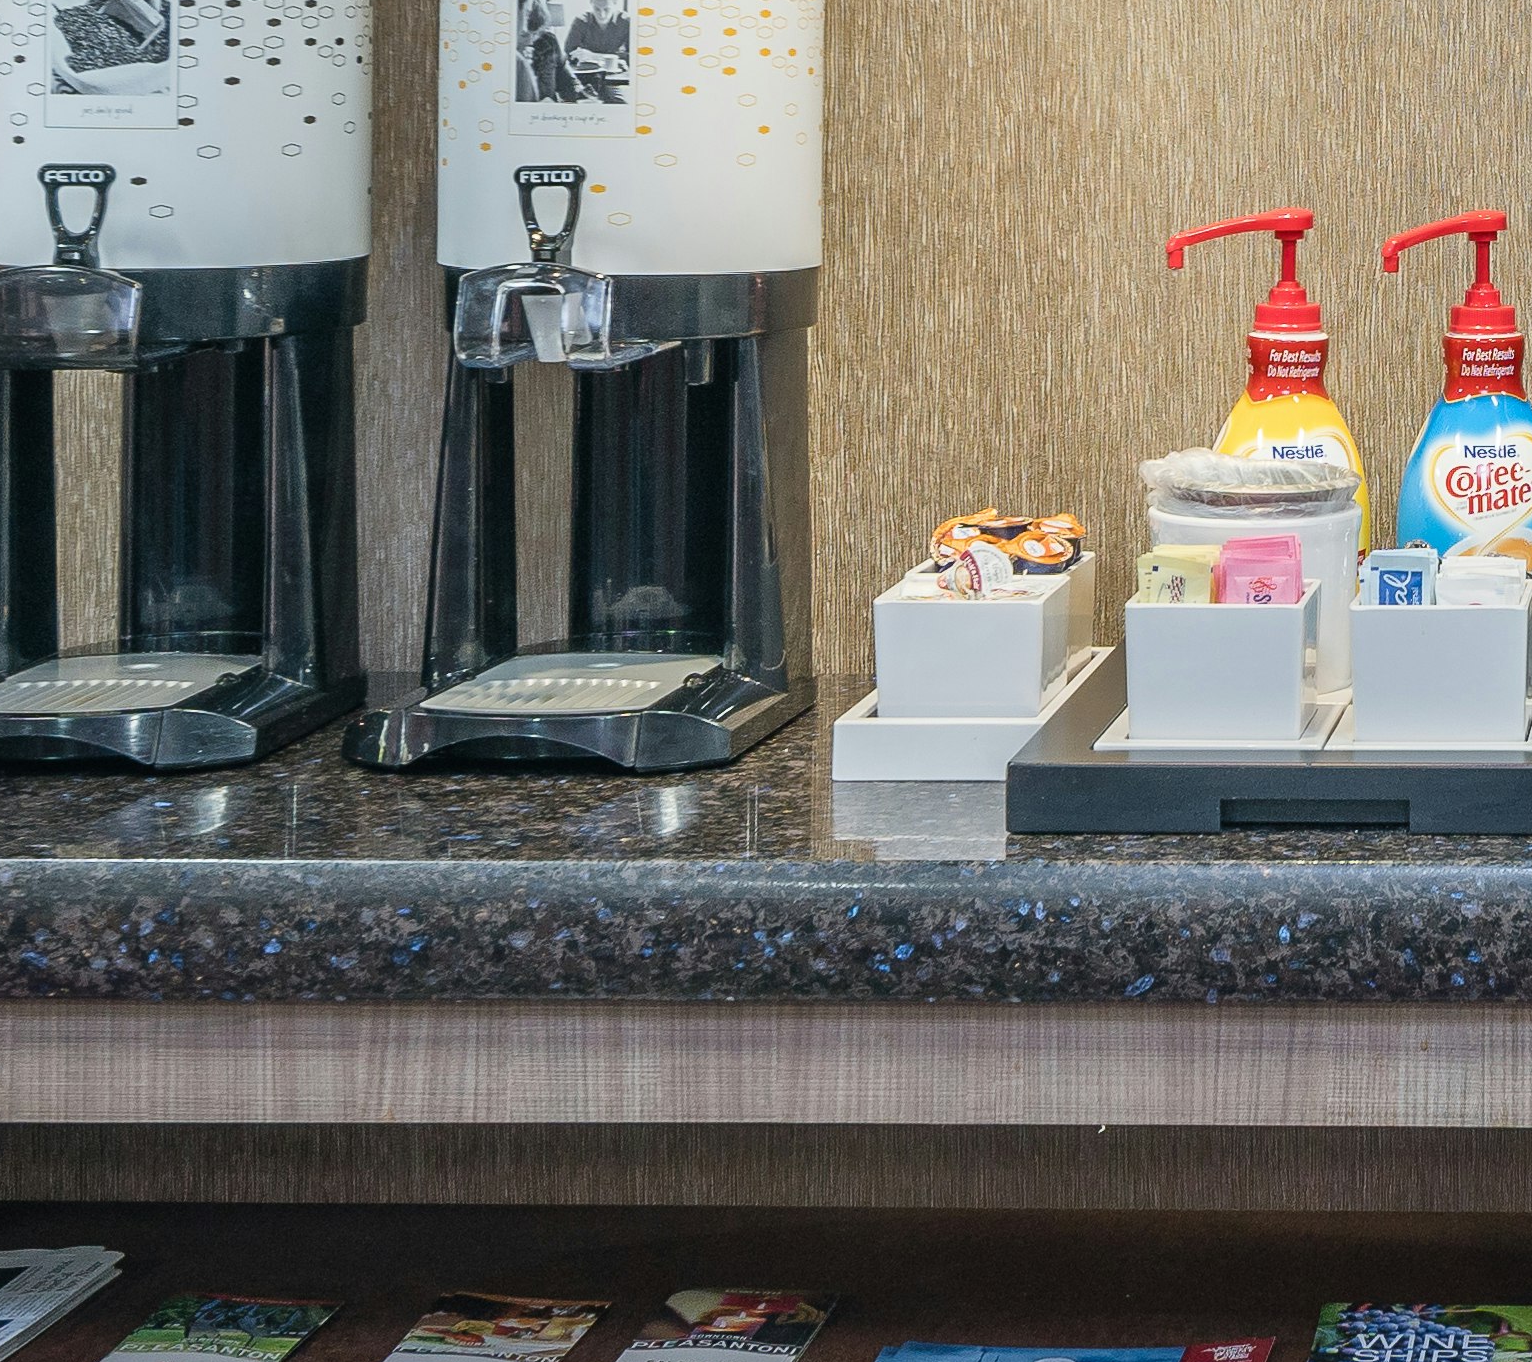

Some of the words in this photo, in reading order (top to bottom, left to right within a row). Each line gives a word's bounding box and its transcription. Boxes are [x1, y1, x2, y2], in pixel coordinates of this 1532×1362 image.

[44, 170, 105, 183] FETCO
[519, 170, 574, 183] FETCO
[1269, 348, 1282, 362] For
[1282, 349, 1299, 363] Best
[1299, 349, 1322, 363] Results
[1462, 347, 1475, 361] For
[1475, 348, 1492, 361] Best
[1492, 346, 1515, 361] Results
[1267, 364, 1277, 377] Do
[1461, 363, 1471, 376] Do
[1356, 1334, 1490, 1349] WINE
[120, 1343, 281, 1362] PLEASANTON
[1353, 1349, 1489, 1362] SHIPS
